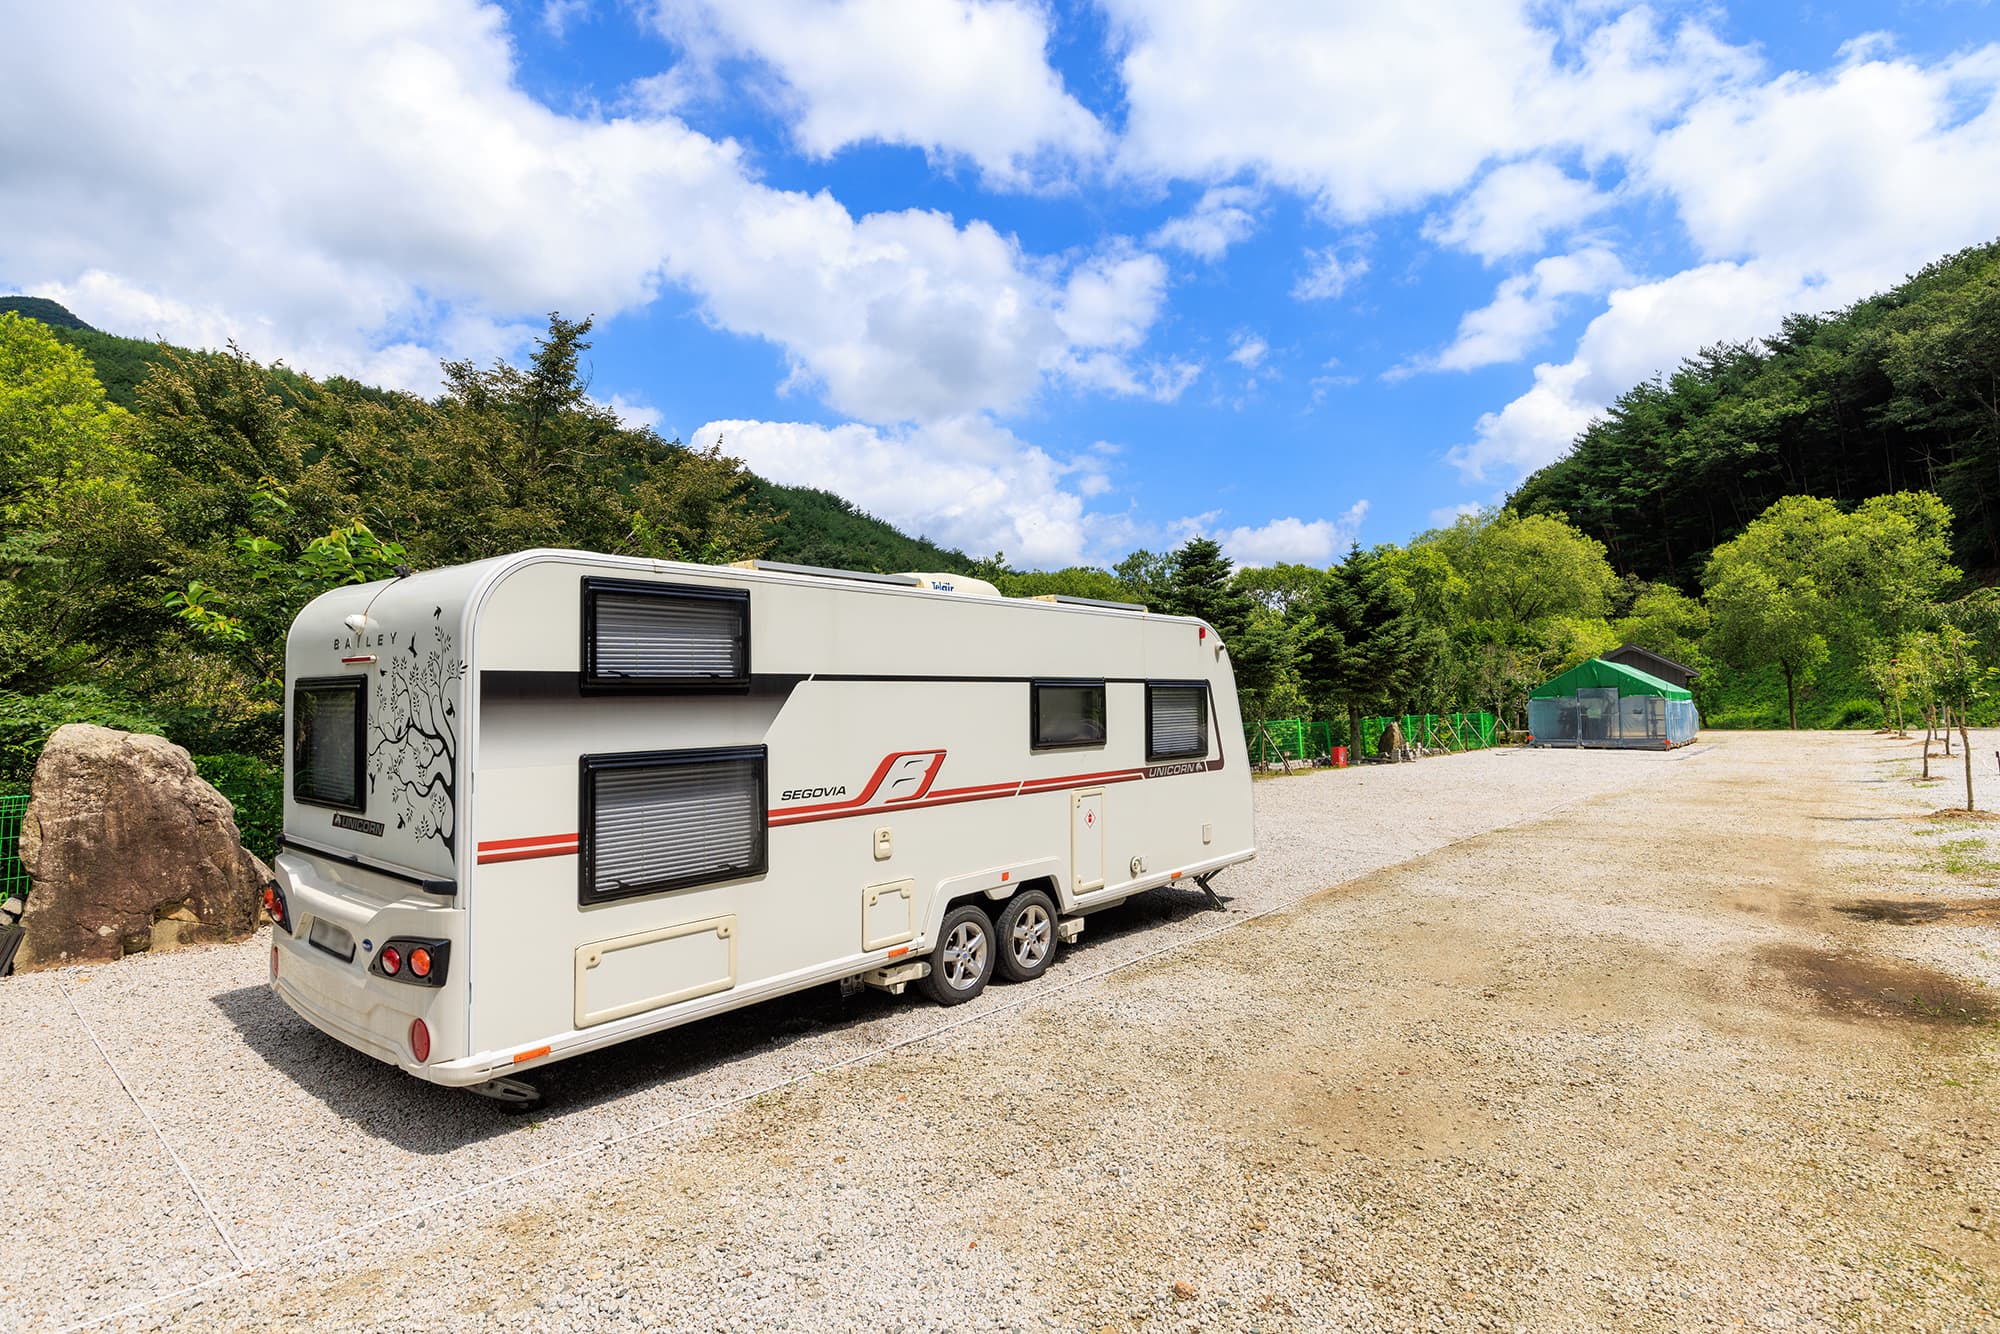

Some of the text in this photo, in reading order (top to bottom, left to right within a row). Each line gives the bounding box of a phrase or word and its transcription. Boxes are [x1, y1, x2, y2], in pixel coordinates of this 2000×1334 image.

[333, 632, 397, 650] BAILEY
[1149, 763, 1195, 777] UNICORN
[781, 786, 846, 800] SEGOVIA
[341, 816, 384, 836] UNICORN
